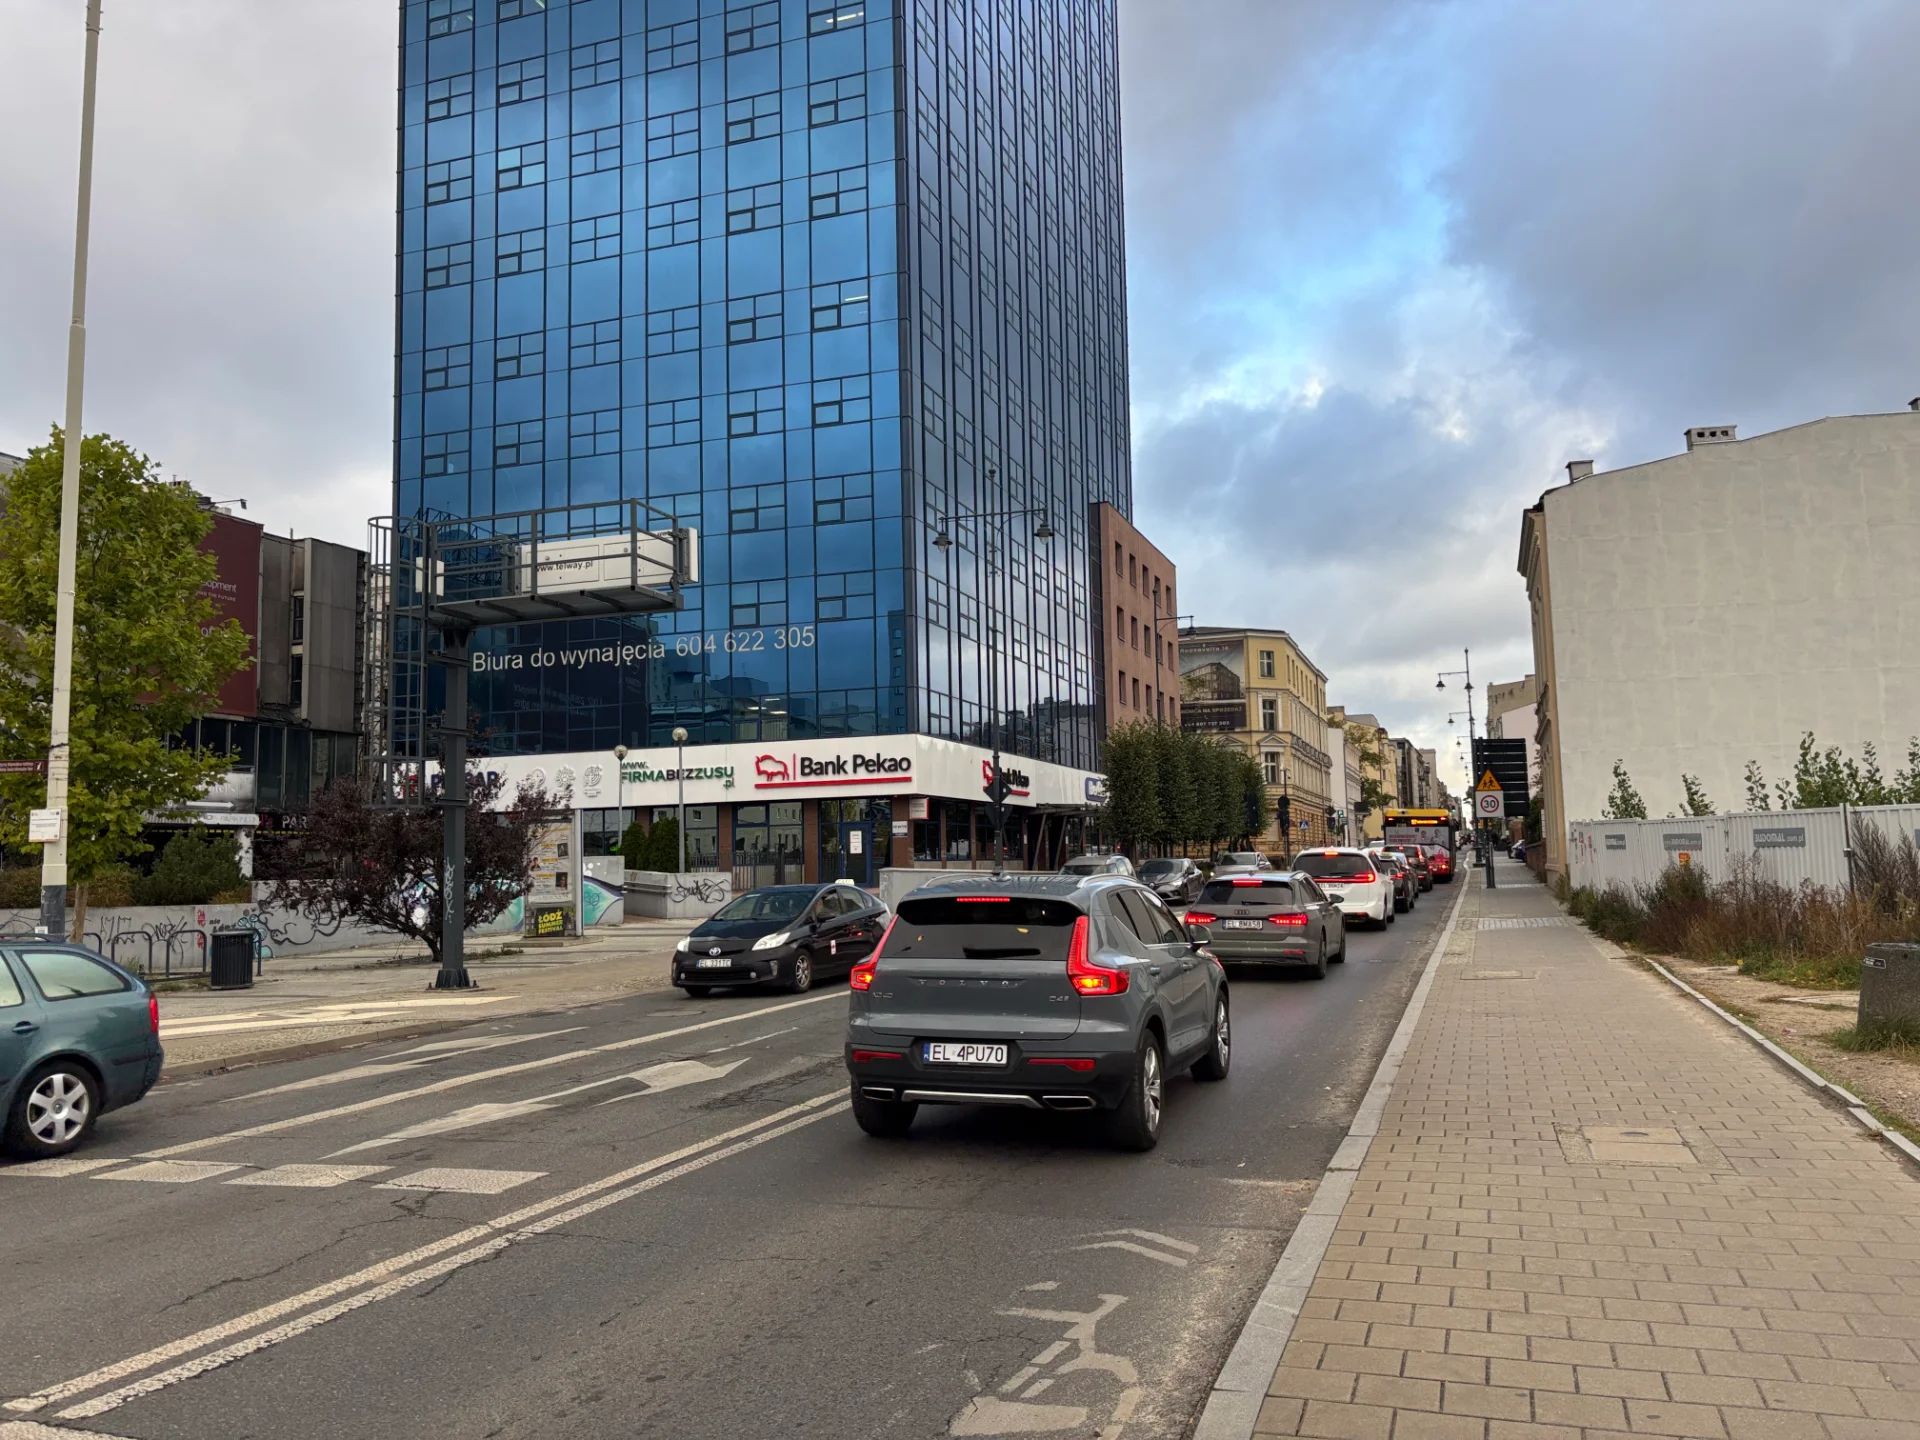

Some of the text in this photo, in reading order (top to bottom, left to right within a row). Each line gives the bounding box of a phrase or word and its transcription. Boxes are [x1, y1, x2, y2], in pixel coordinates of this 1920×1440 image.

[204, 580, 237, 593] opment
[472, 626, 815, 672] Biura do wynajęcia 604 622 305
[622, 761, 649, 769] www.
[800, 752, 912, 777] Bank Pekao
[1484, 800, 1496, 808] 30
[538, 909, 563, 923] ŁÓDŹ
[539, 926, 563, 935] FESTIVAL
[932, 1045, 1004, 1063] EL 4PU70
